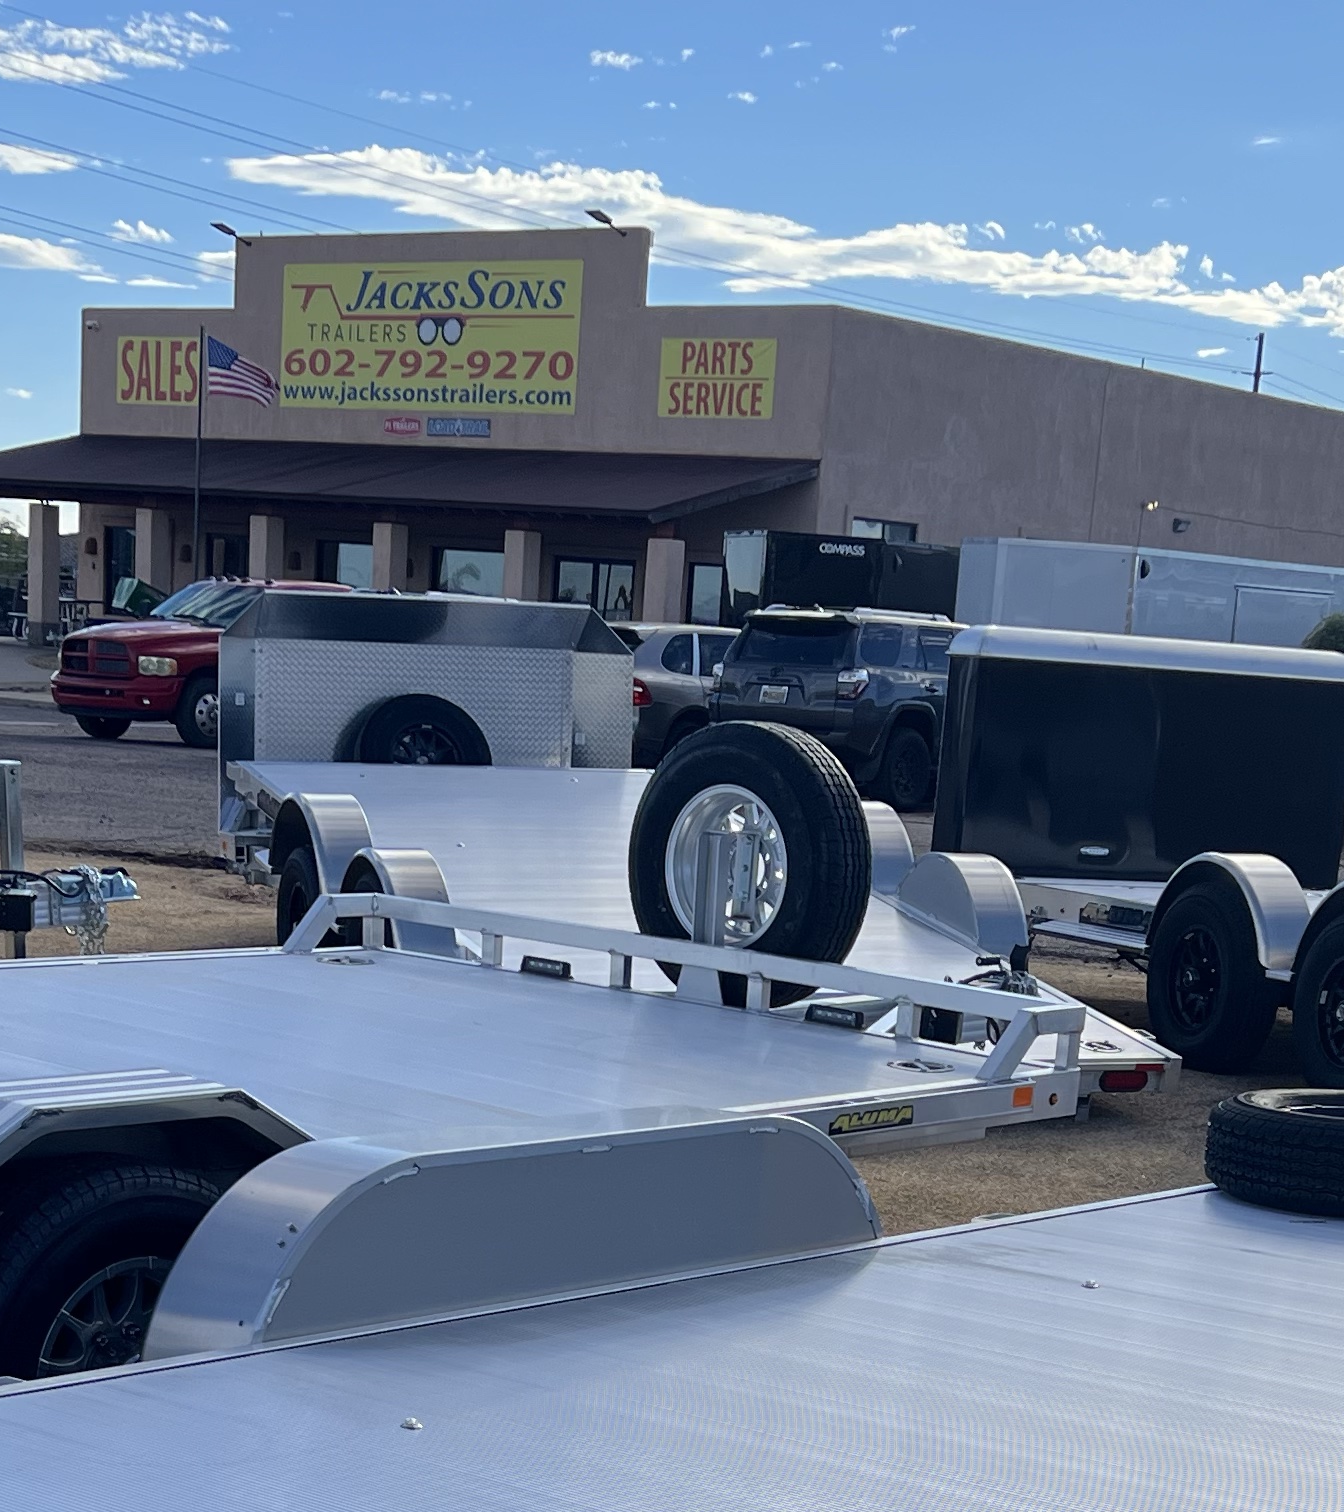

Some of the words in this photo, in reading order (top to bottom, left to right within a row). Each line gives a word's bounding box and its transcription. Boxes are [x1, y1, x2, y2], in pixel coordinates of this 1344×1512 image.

[307, 322, 407, 343] TRAILERS
[121, 339, 199, 402] SALES
[284, 348, 574, 381] 602-792-9270
[681, 341, 754, 376] PARTS
[283, 381, 572, 406] www.jackssonstrailers.com
[667, 381, 764, 417] SERVICE
[818, 541, 866, 557] COMPASS
[829, 1105, 914, 1135] ALUMA
